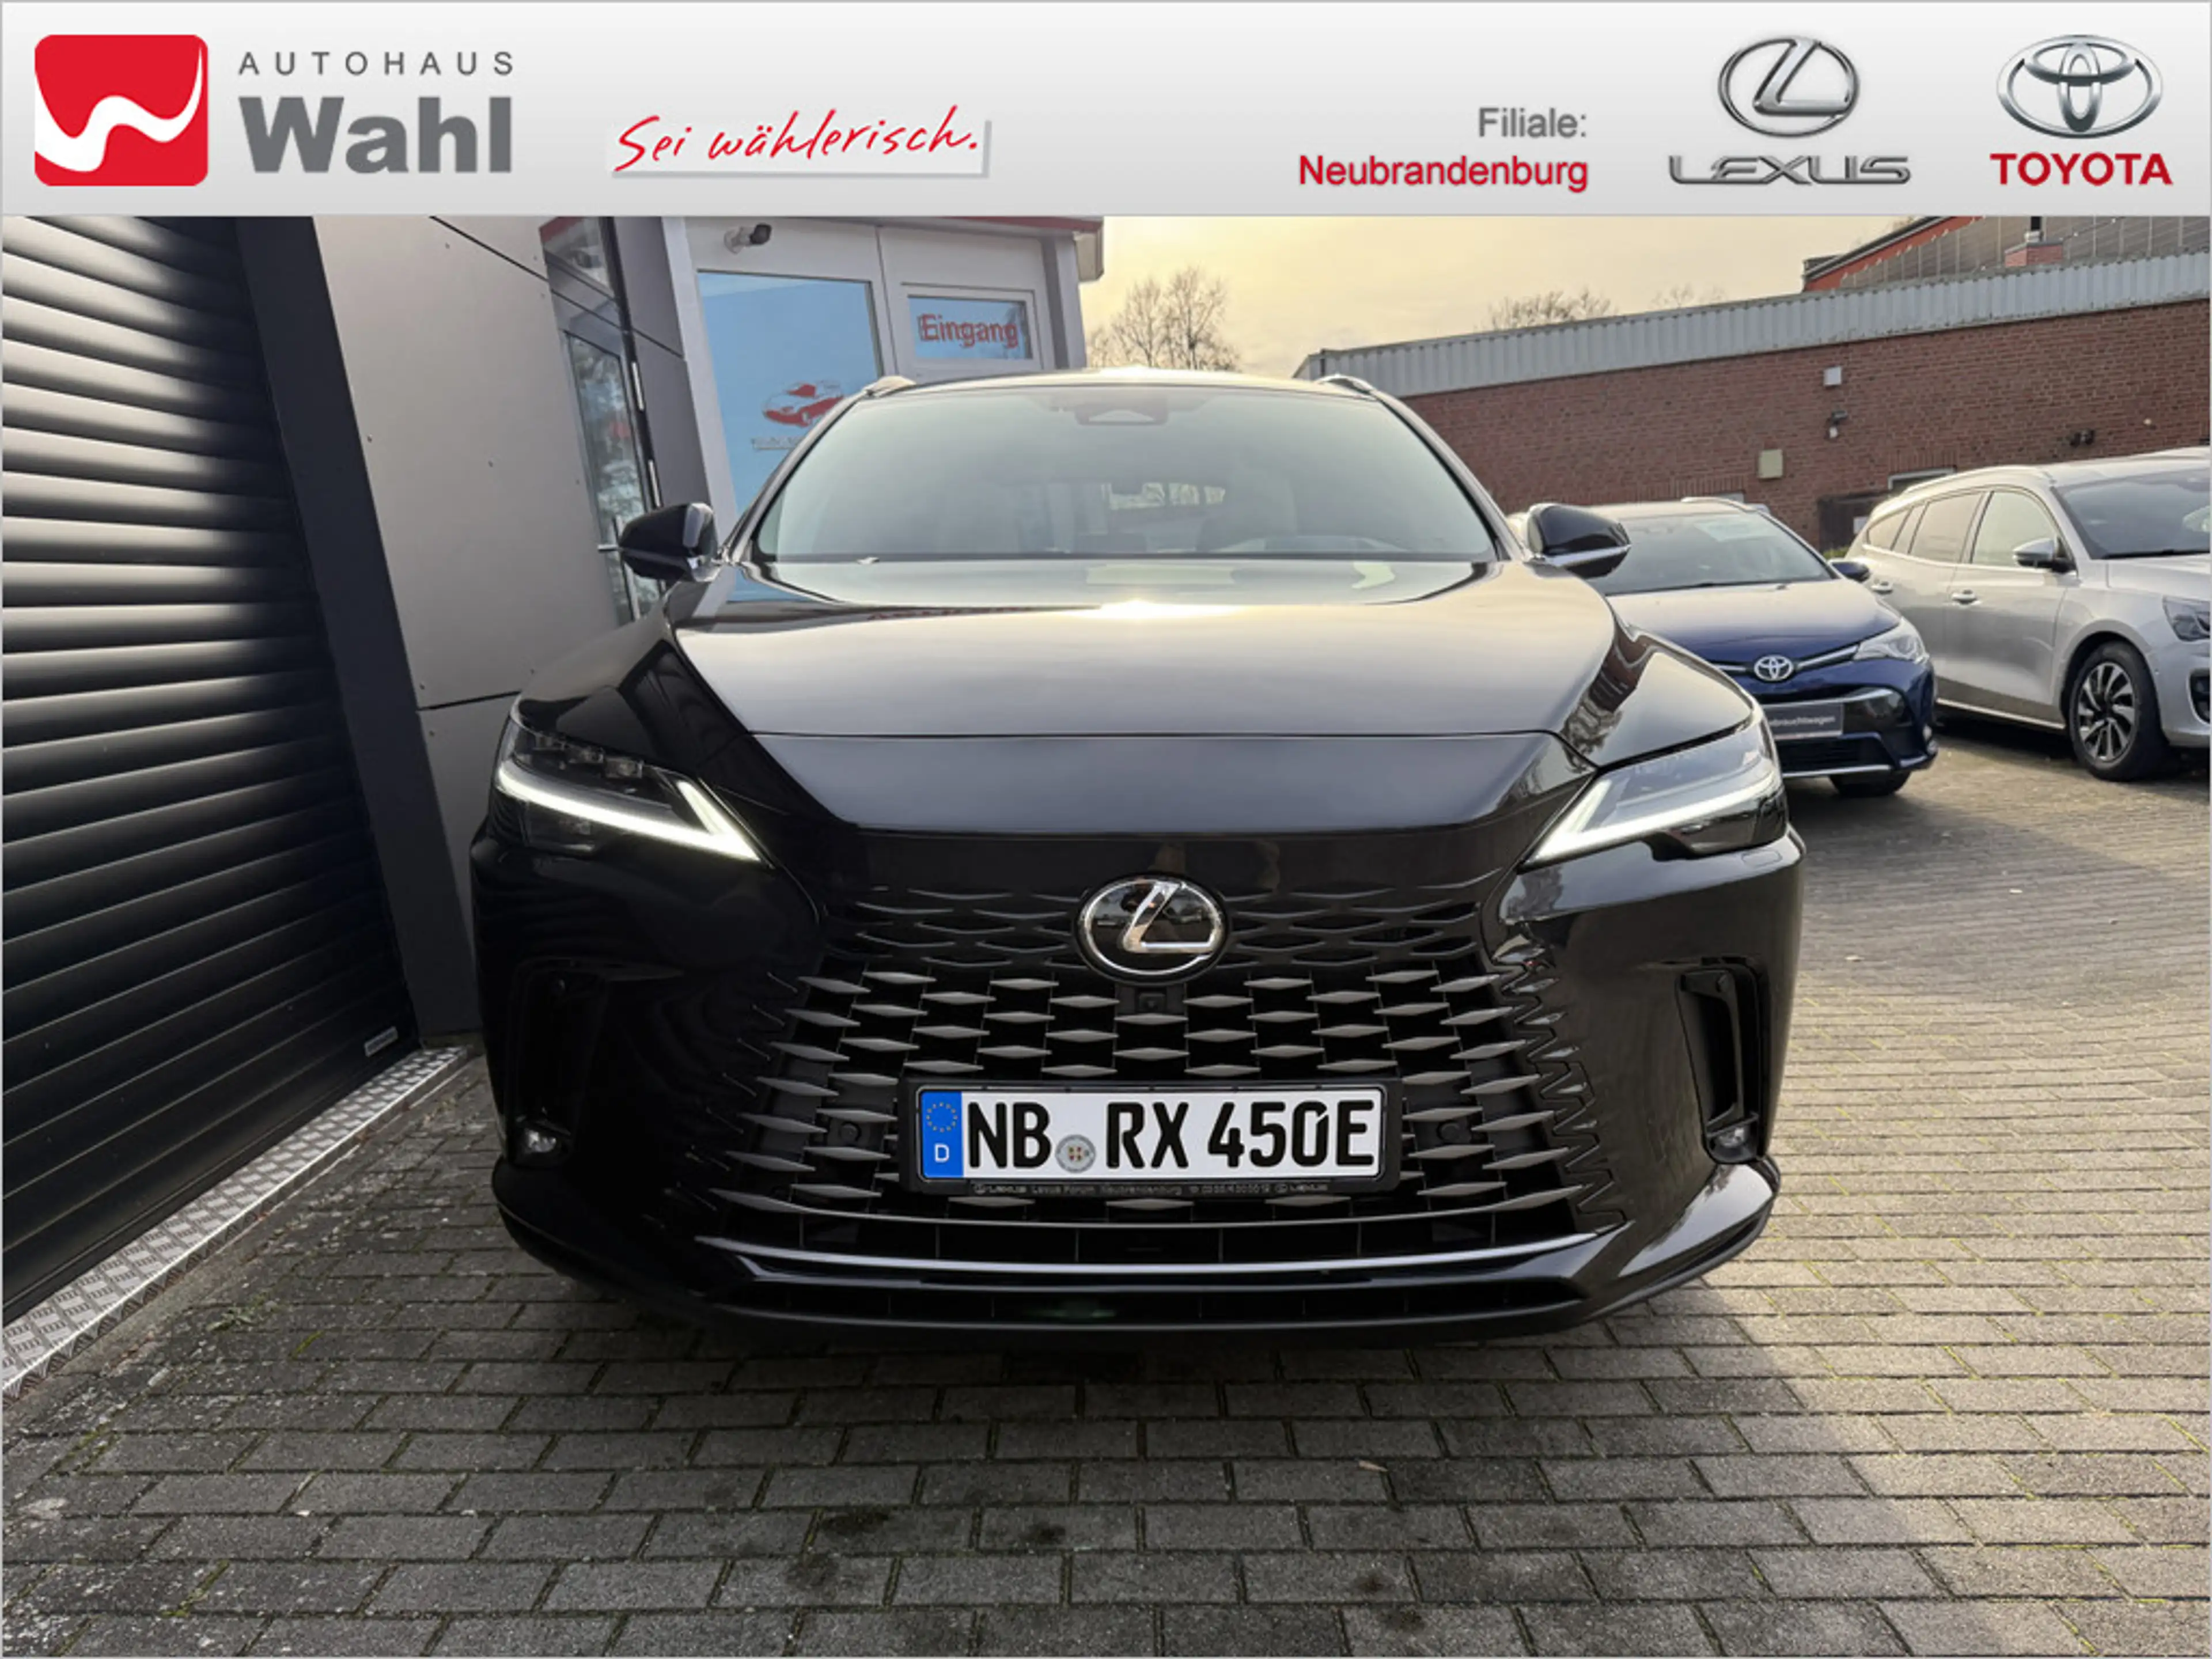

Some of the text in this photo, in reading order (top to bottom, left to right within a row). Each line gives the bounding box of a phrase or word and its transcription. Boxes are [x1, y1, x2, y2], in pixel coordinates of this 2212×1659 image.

[918, 313, 1018, 349] Eingang
[968, 1100, 1374, 1169] NB RX 450E
[934, 1143, 950, 1163] D
